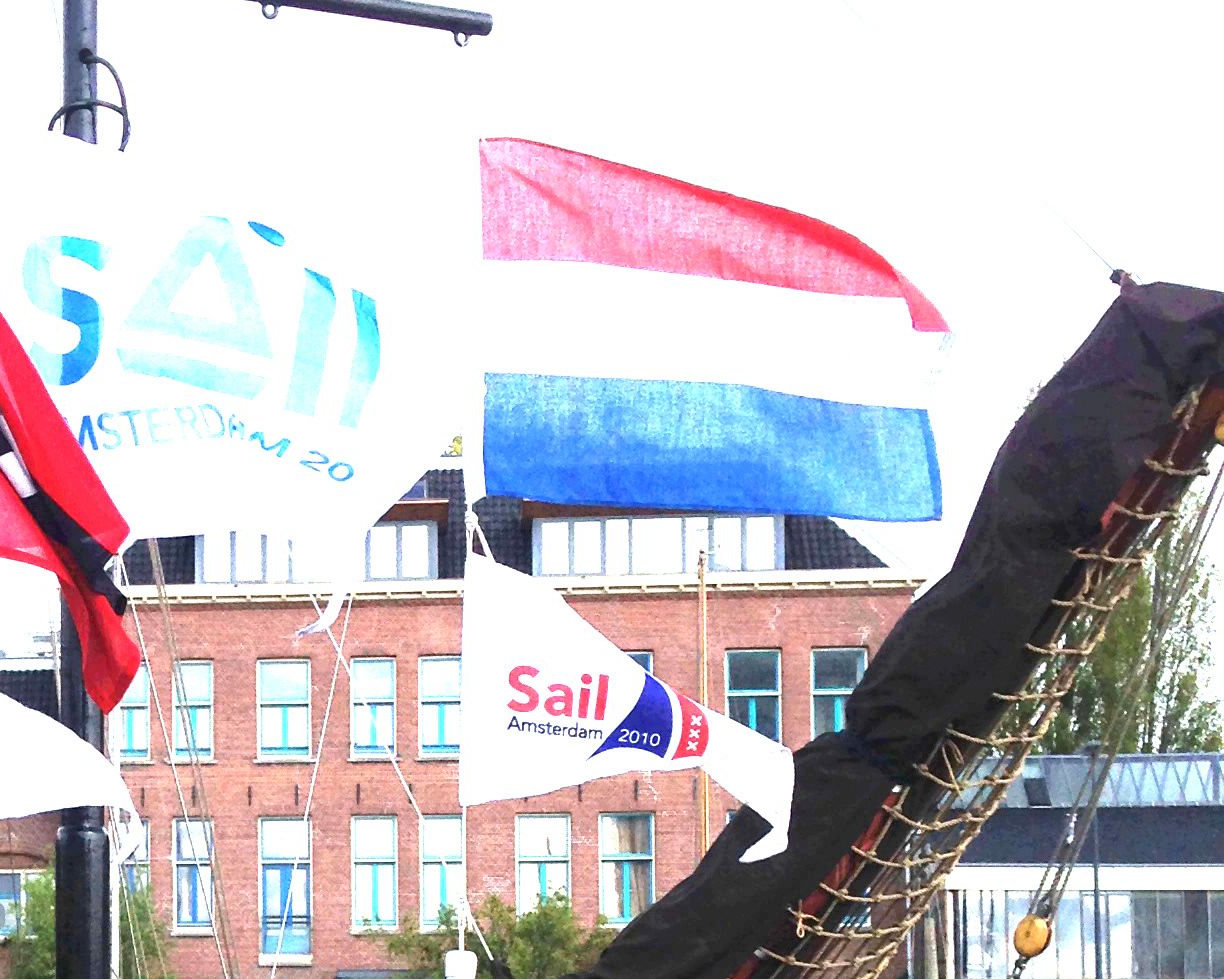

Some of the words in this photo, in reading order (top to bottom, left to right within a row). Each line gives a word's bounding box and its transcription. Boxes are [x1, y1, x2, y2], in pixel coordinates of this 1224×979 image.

[507, 665, 609, 720] Sail
[507, 716, 603, 740] Amsterdam
[618, 728, 661, 747] 2010
